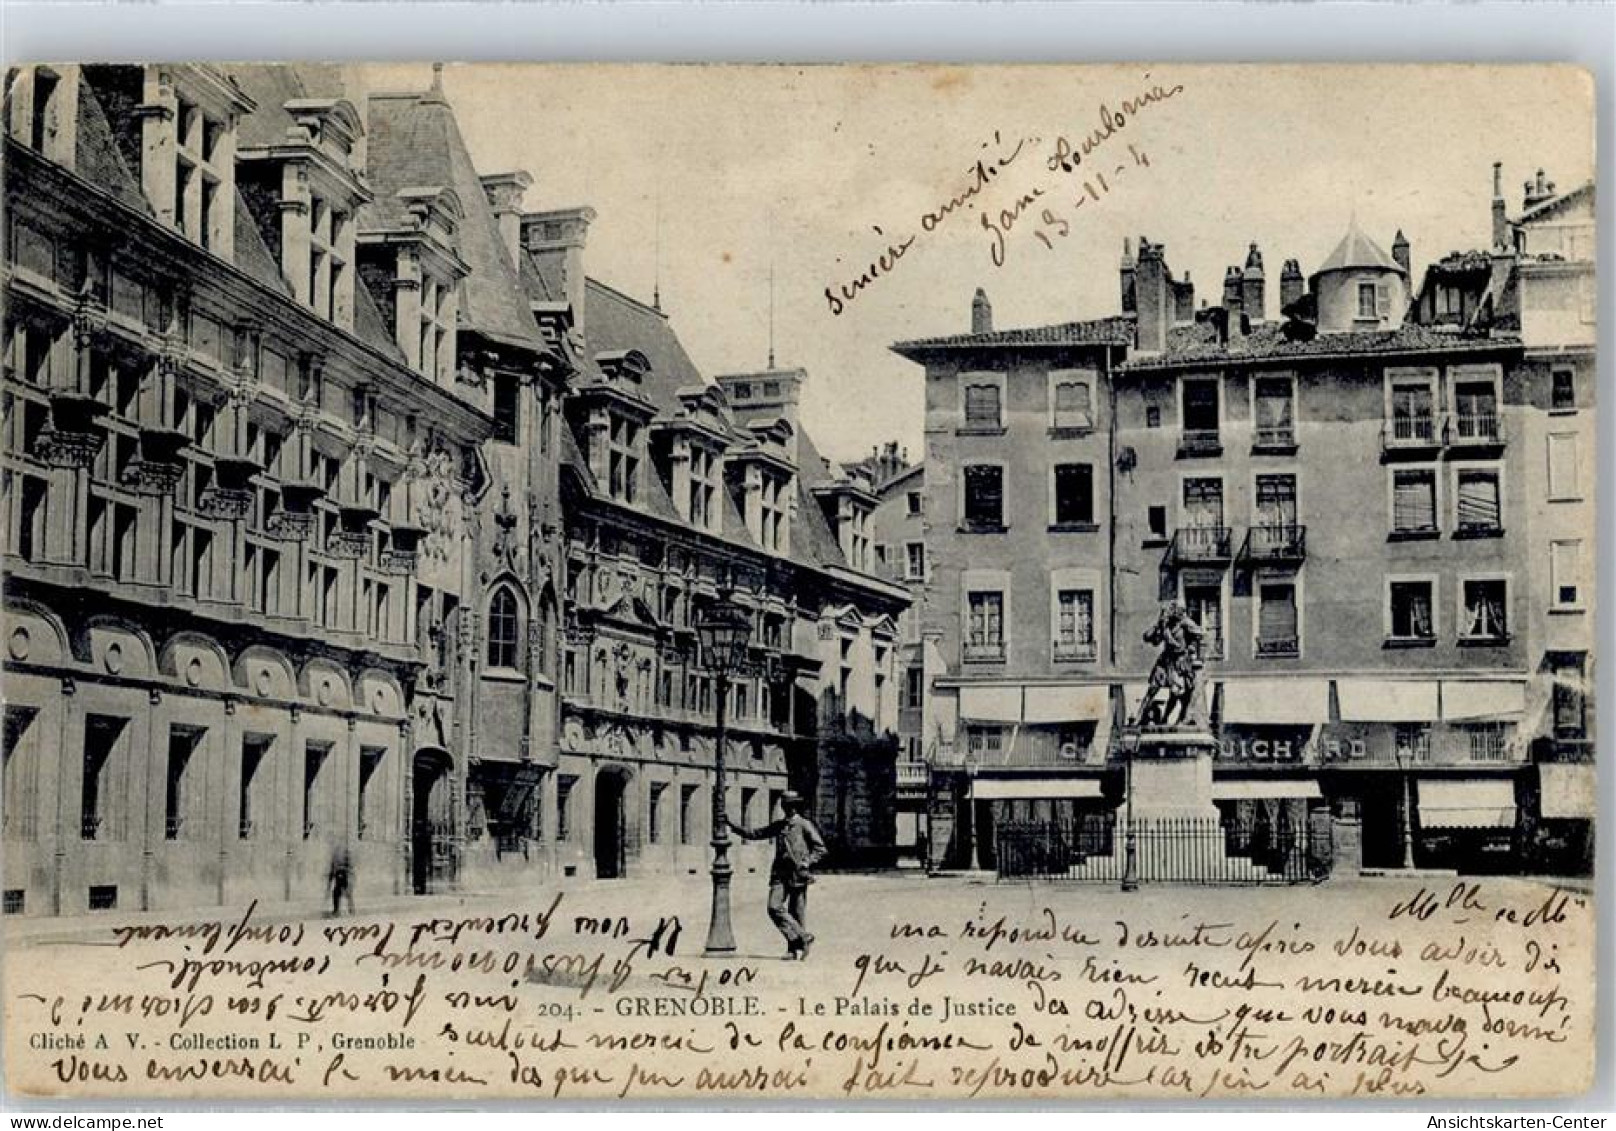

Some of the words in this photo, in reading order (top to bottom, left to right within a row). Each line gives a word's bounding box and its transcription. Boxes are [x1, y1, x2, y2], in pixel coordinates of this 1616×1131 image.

[1211, 739, 1368, 759] UICHRD
[1334, 926, 1402, 959] vous
[1420, 936, 1506, 968] avoir
[538, 1000, 581, 1020] 204.
[616, 996, 767, 1018] GRENOBLE.
[799, 997, 826, 1016] Le
[834, 996, 900, 1017] Palais
[907, 996, 933, 1017] de
[940, 996, 1017, 1021] Justice
[1303, 1006, 1367, 1026] vous
[29, 1033, 86, 1050] Cliché
[170, 1032, 260, 1050] Collection
[331, 1032, 416, 1050] Grenoble
[724, 1022, 762, 1050] de
[1008, 1022, 1043, 1049] de
